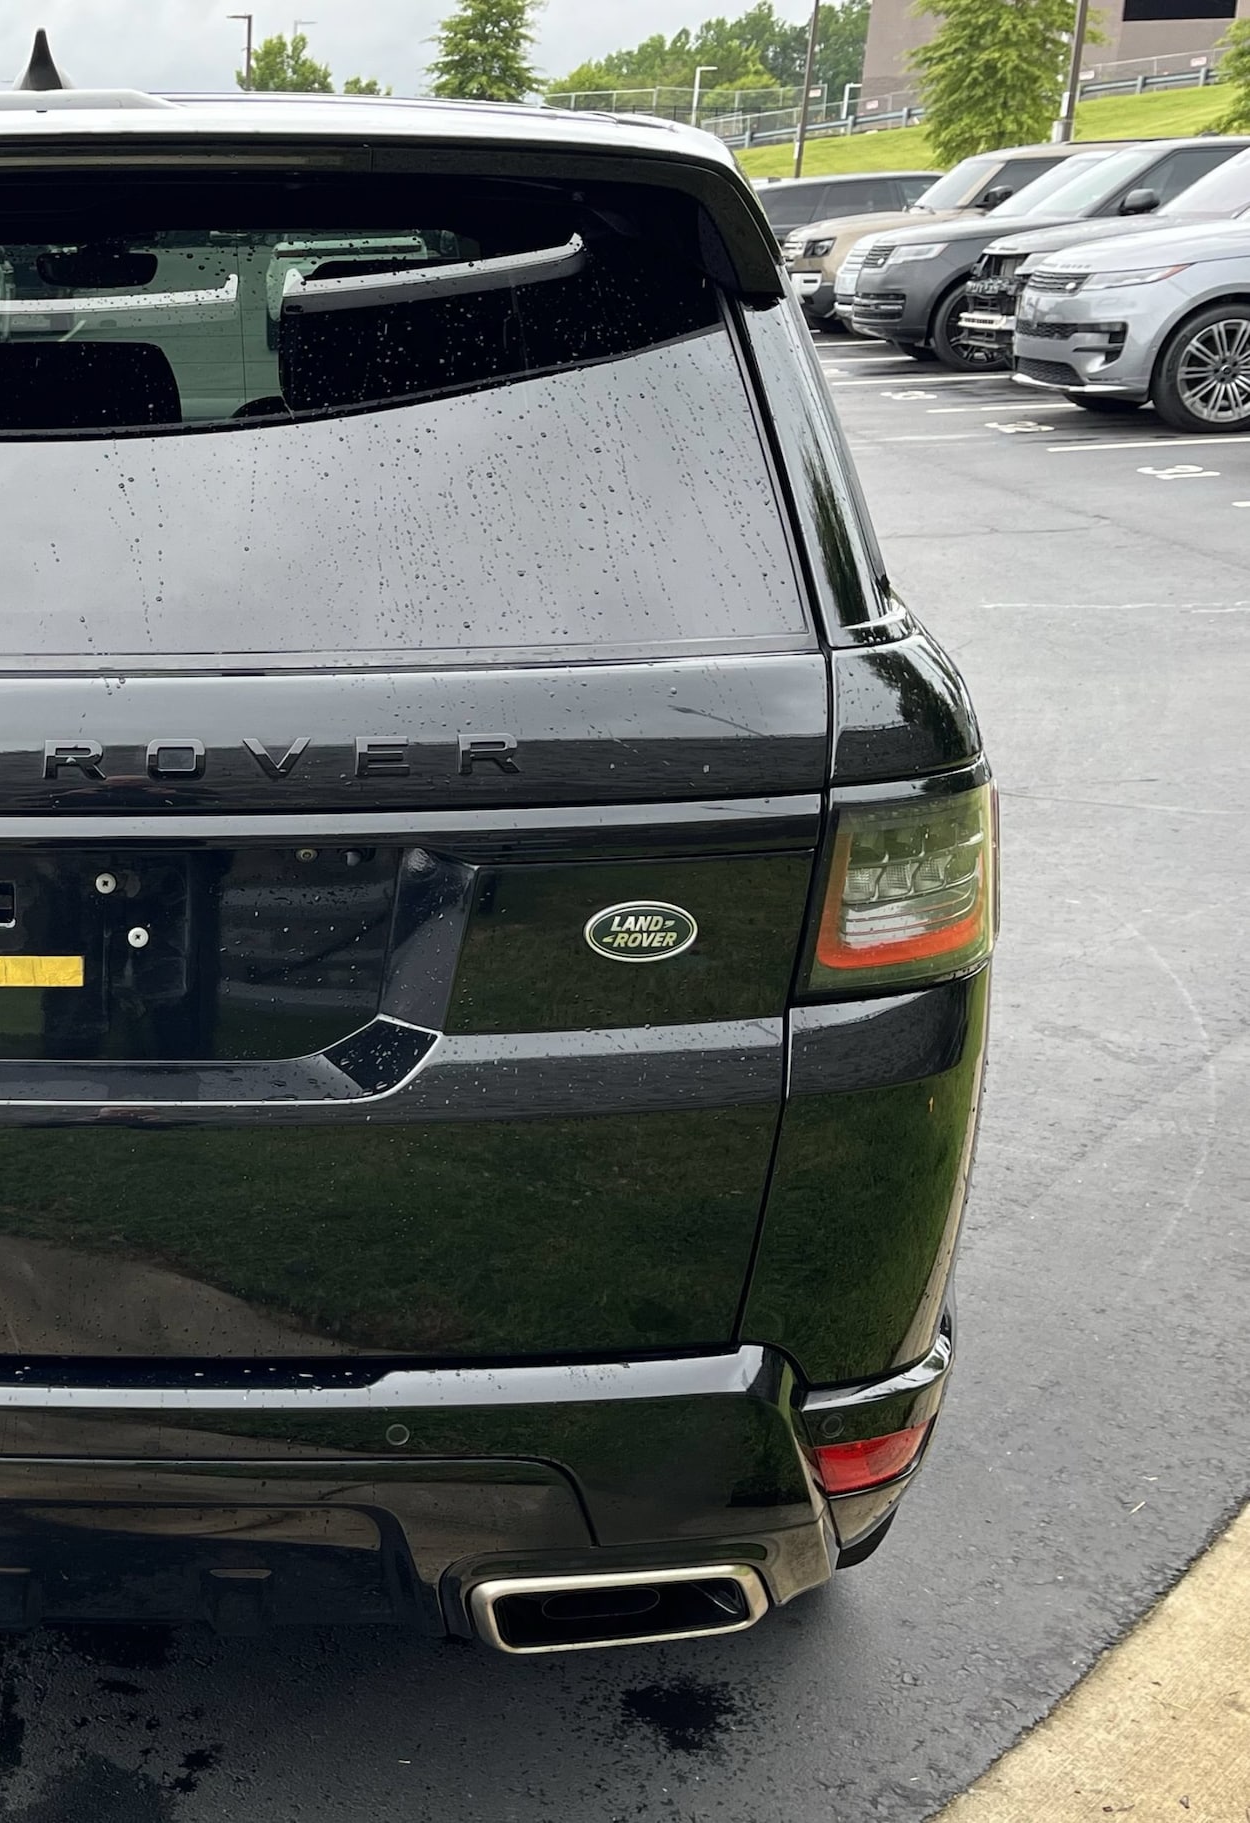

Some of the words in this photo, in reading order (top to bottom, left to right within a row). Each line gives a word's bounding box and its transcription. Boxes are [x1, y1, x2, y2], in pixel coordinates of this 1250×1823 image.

[42, 732, 521, 780] ROVER
[611, 916, 664, 931] LAND
[612, 932, 678, 947] ROVER
